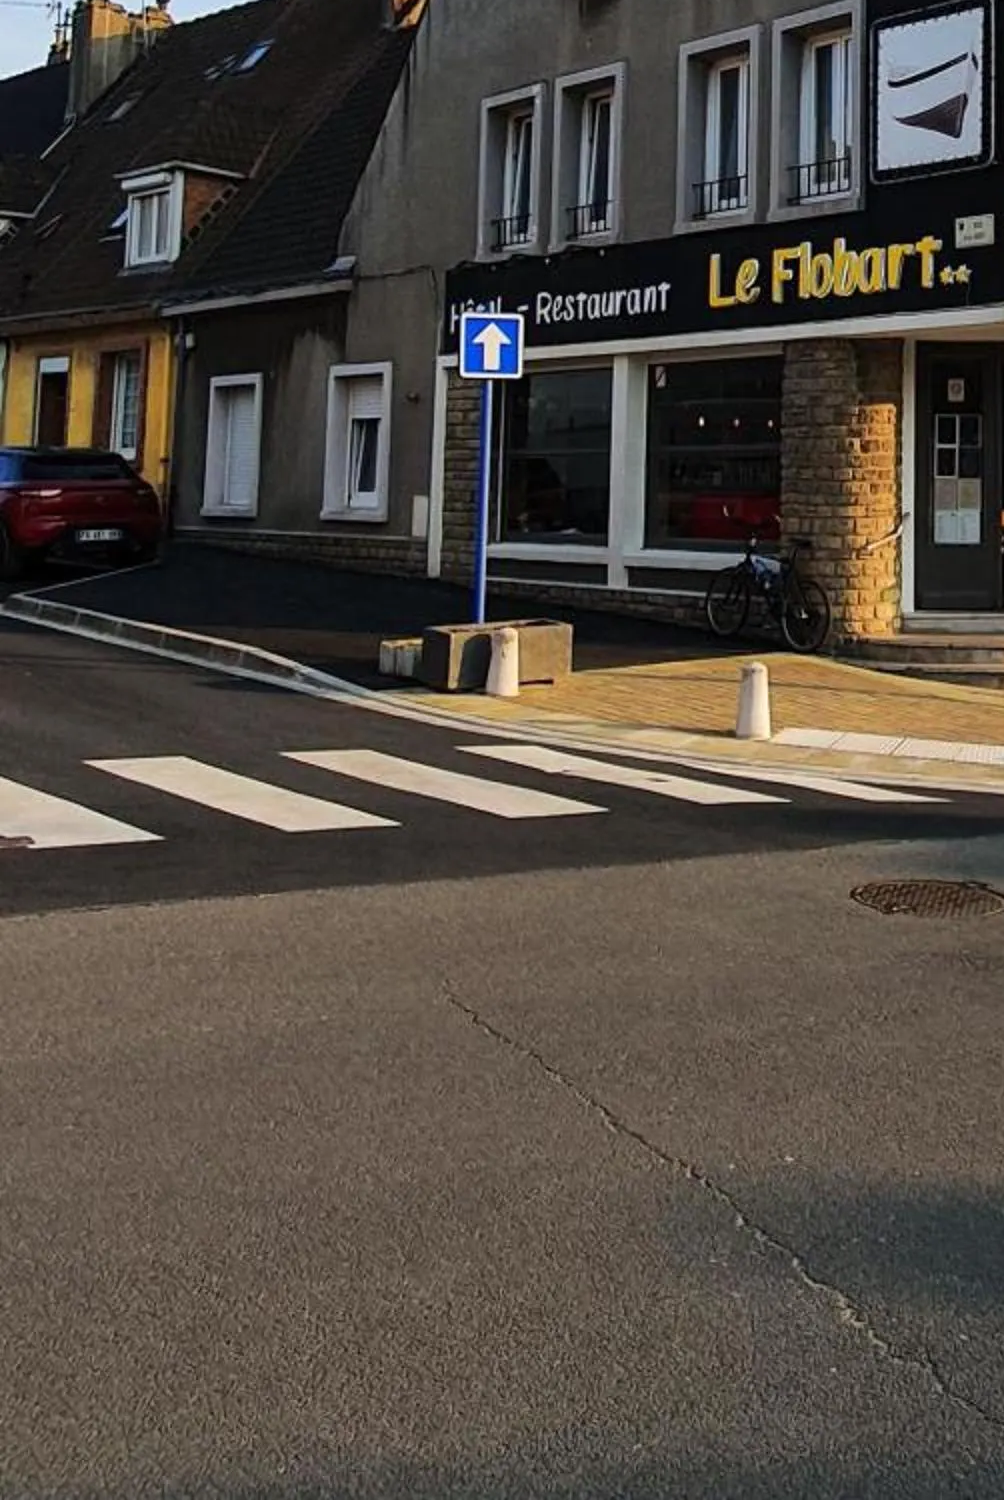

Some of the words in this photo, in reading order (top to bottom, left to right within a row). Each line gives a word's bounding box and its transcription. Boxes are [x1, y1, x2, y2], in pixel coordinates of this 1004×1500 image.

[709, 253, 761, 308] Le
[772, 235, 943, 304] Flobart
[536, 281, 671, 324] Restaurant
